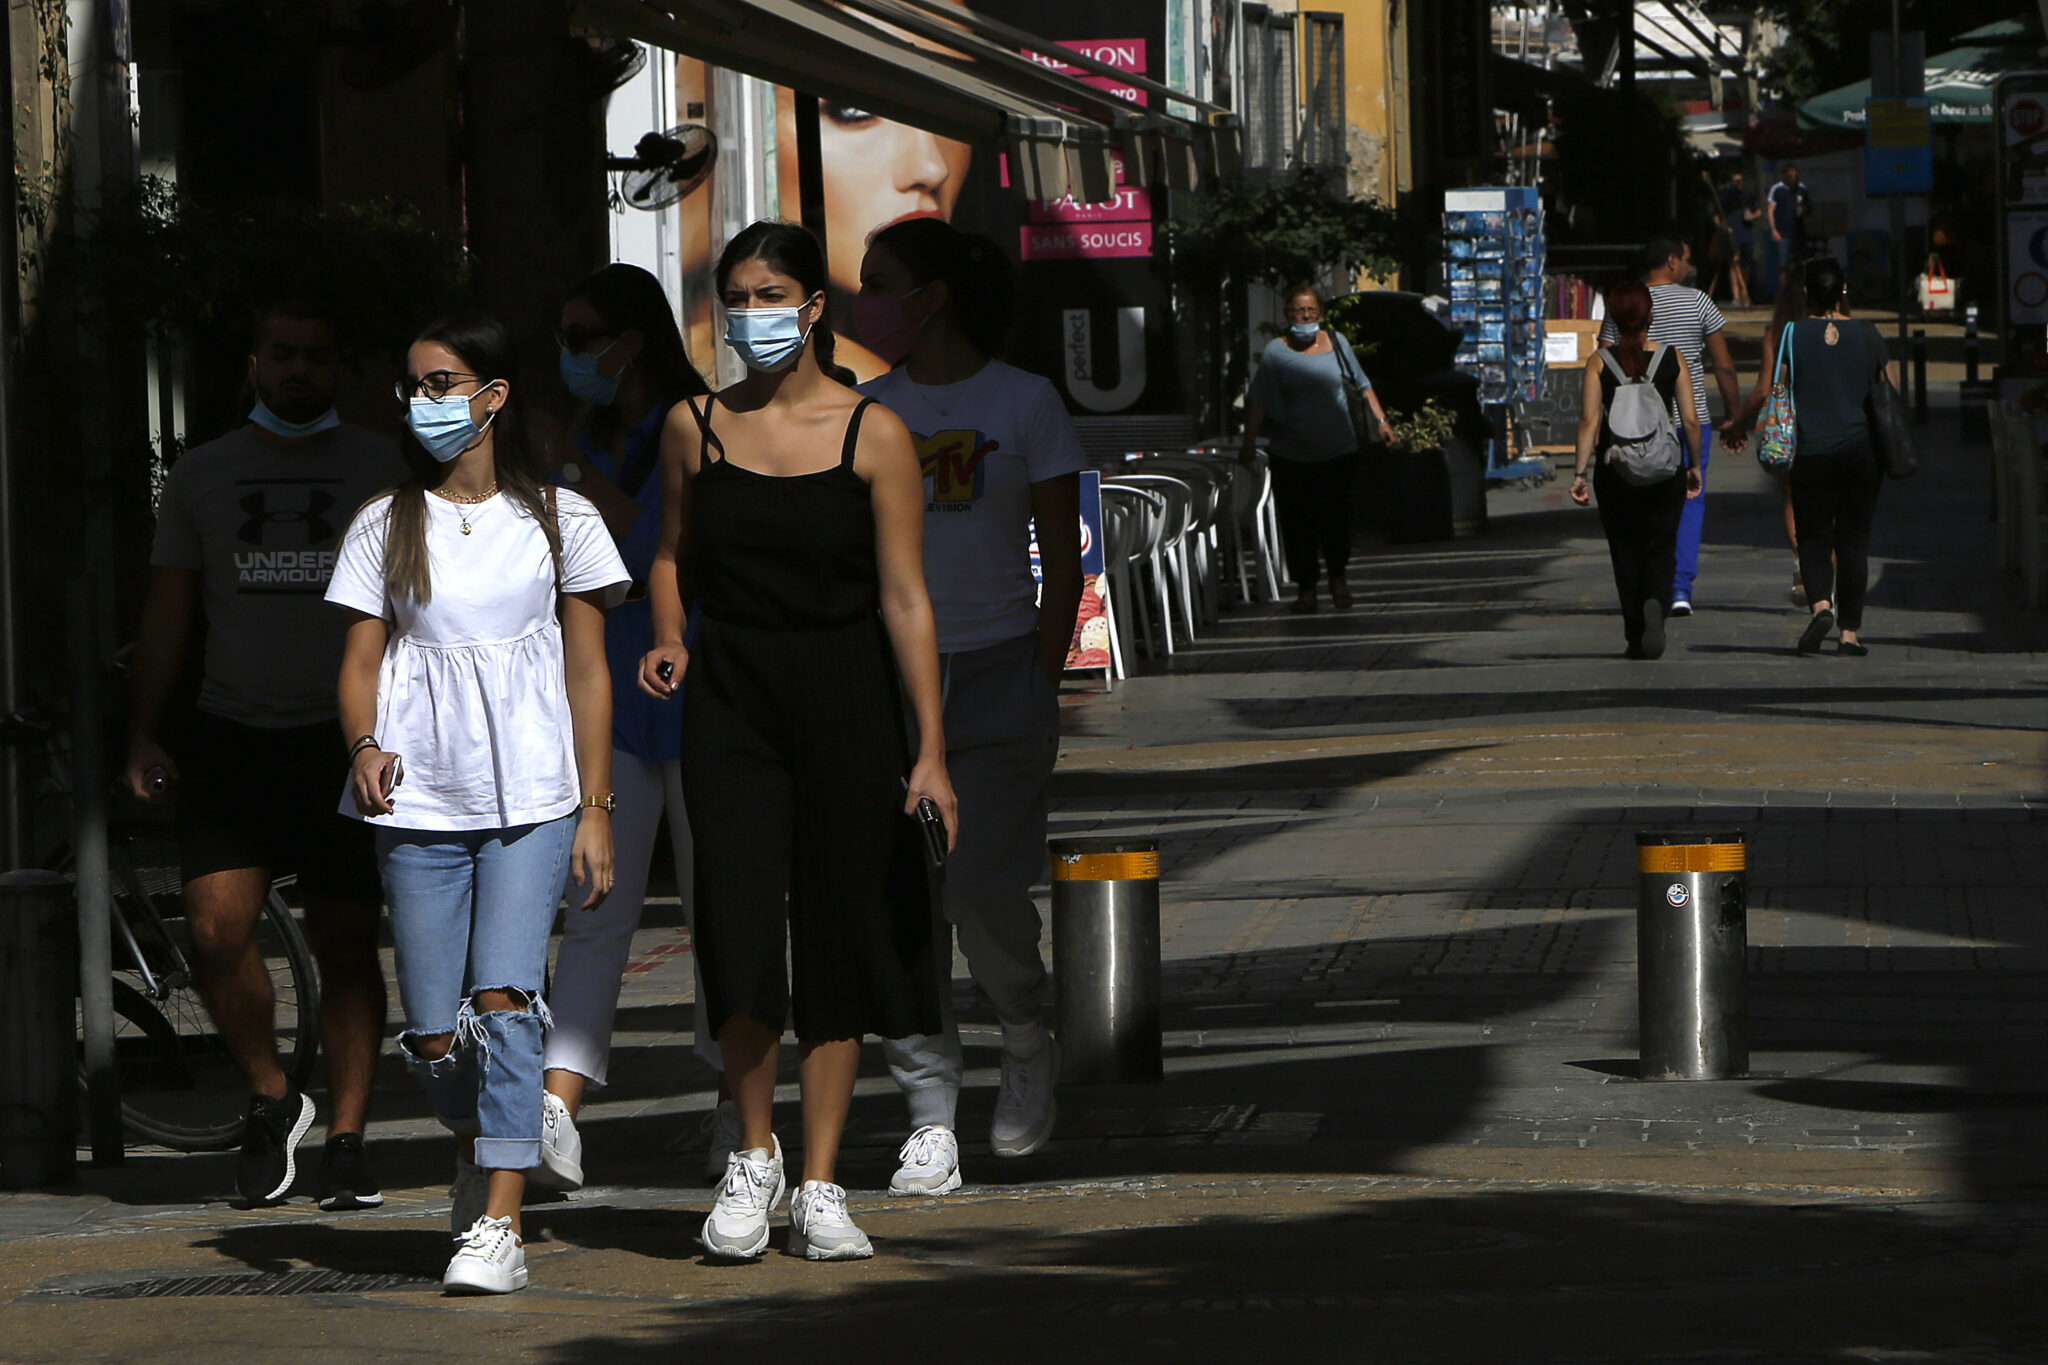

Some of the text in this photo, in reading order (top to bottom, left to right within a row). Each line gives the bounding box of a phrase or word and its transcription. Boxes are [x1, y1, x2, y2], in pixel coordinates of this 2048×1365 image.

[1032, 47, 1136, 69] RON
[1031, 232, 1142, 250] SANS SOUCIS
[1067, 313, 1093, 381] perfect
[233, 551, 337, 569] UNDER
